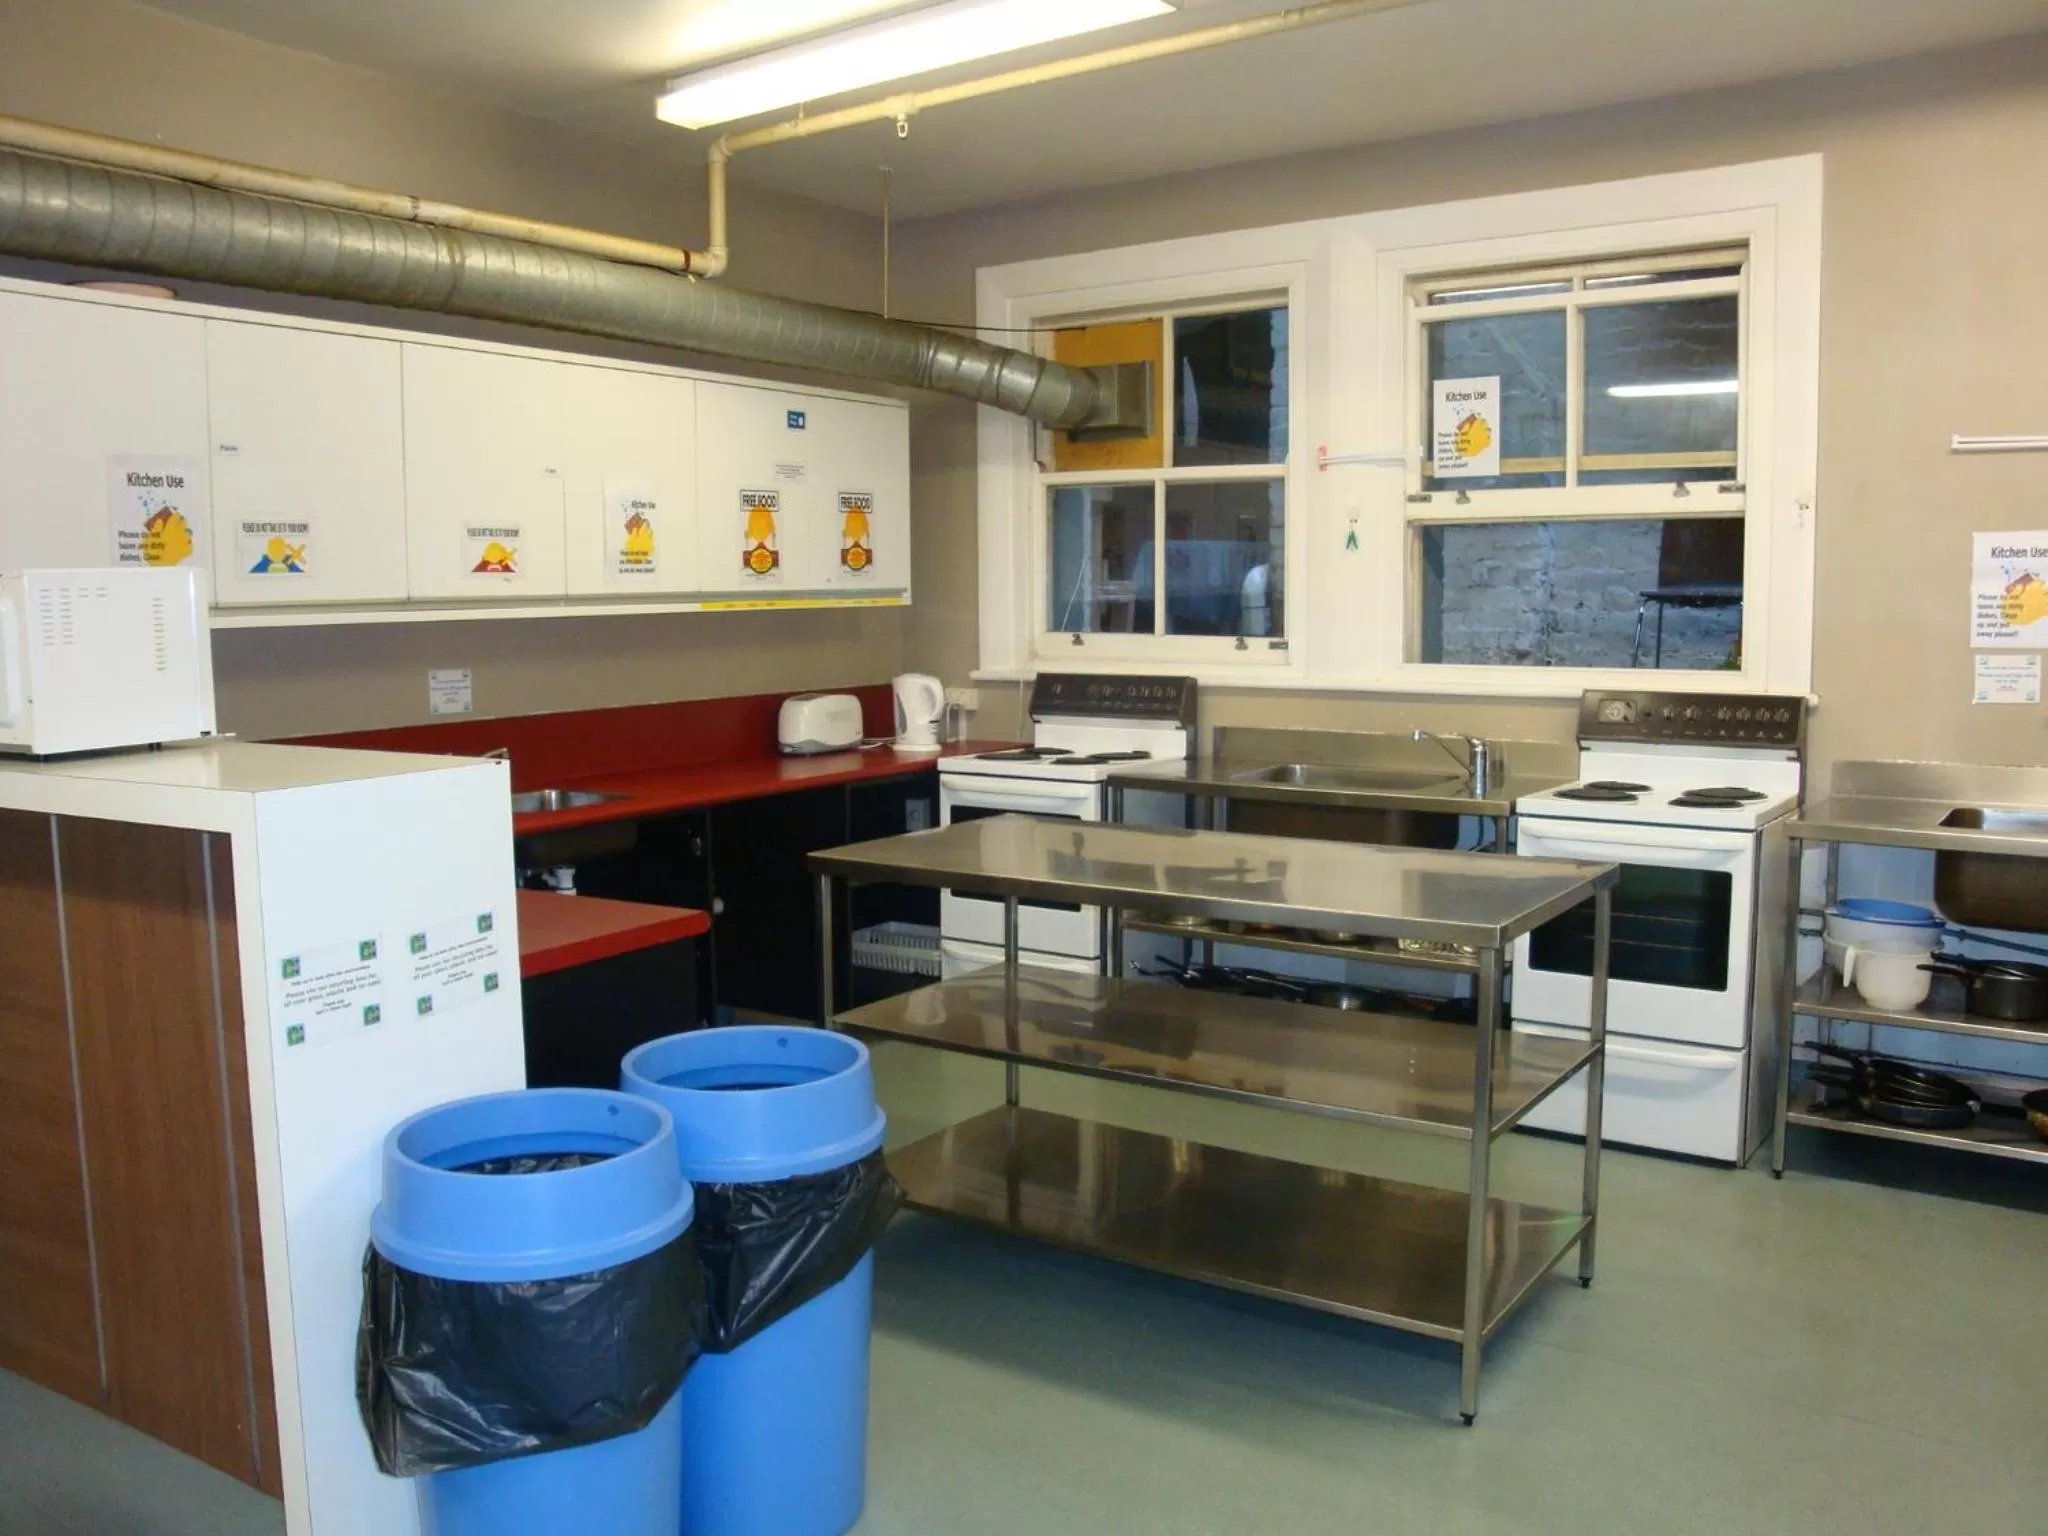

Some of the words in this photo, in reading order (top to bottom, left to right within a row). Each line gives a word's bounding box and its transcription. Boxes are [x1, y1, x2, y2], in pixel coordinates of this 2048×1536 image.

[1445, 391, 1472, 402] Kitchen
[1473, 391, 1487, 400] Use
[126, 472, 164, 488] Kitchen
[166, 475, 184, 488] Use
[743, 494, 757, 507] FREE
[758, 494, 776, 508] FOOD
[841, 496, 853, 508] FREE
[854, 496, 870, 509] FOOD
[1991, 546, 2027, 559] Kitchen
